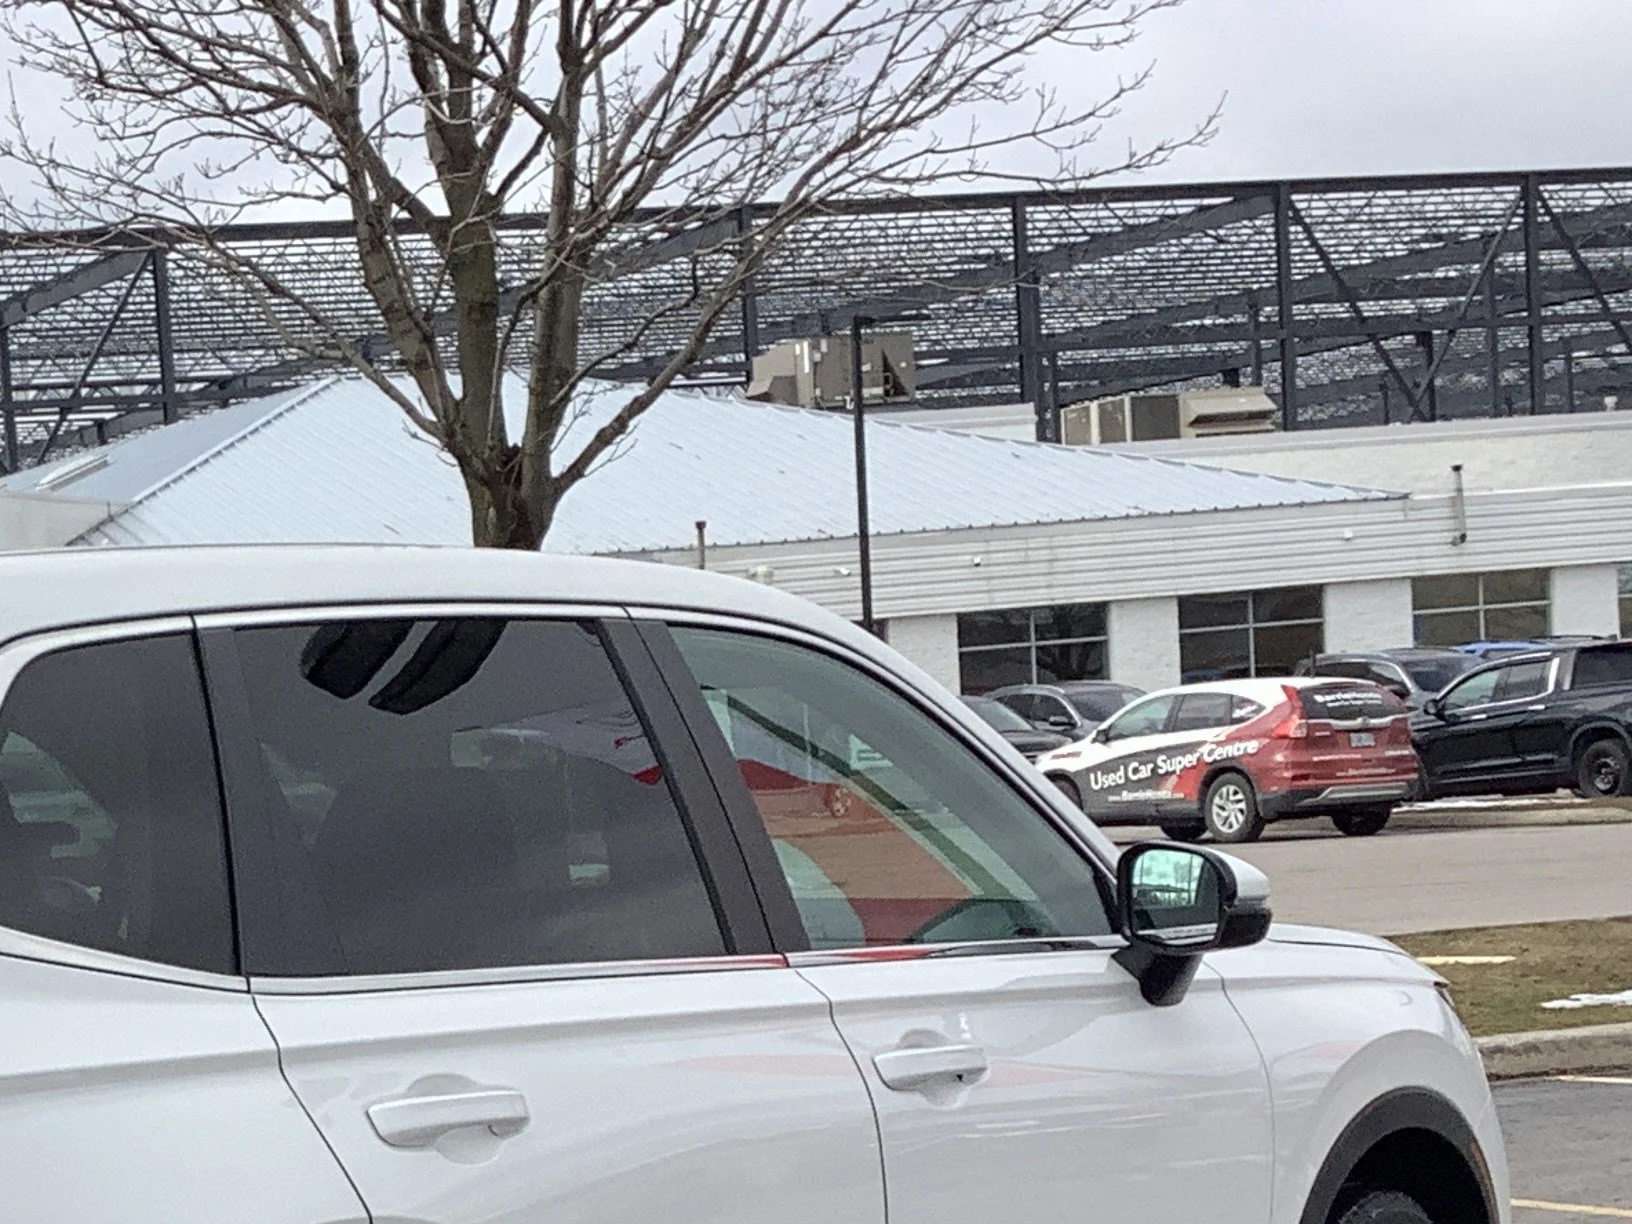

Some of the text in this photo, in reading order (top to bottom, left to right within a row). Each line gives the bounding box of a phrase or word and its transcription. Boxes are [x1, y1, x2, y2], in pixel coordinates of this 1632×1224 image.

[1089, 738, 1260, 791] Used Car Super Centre
